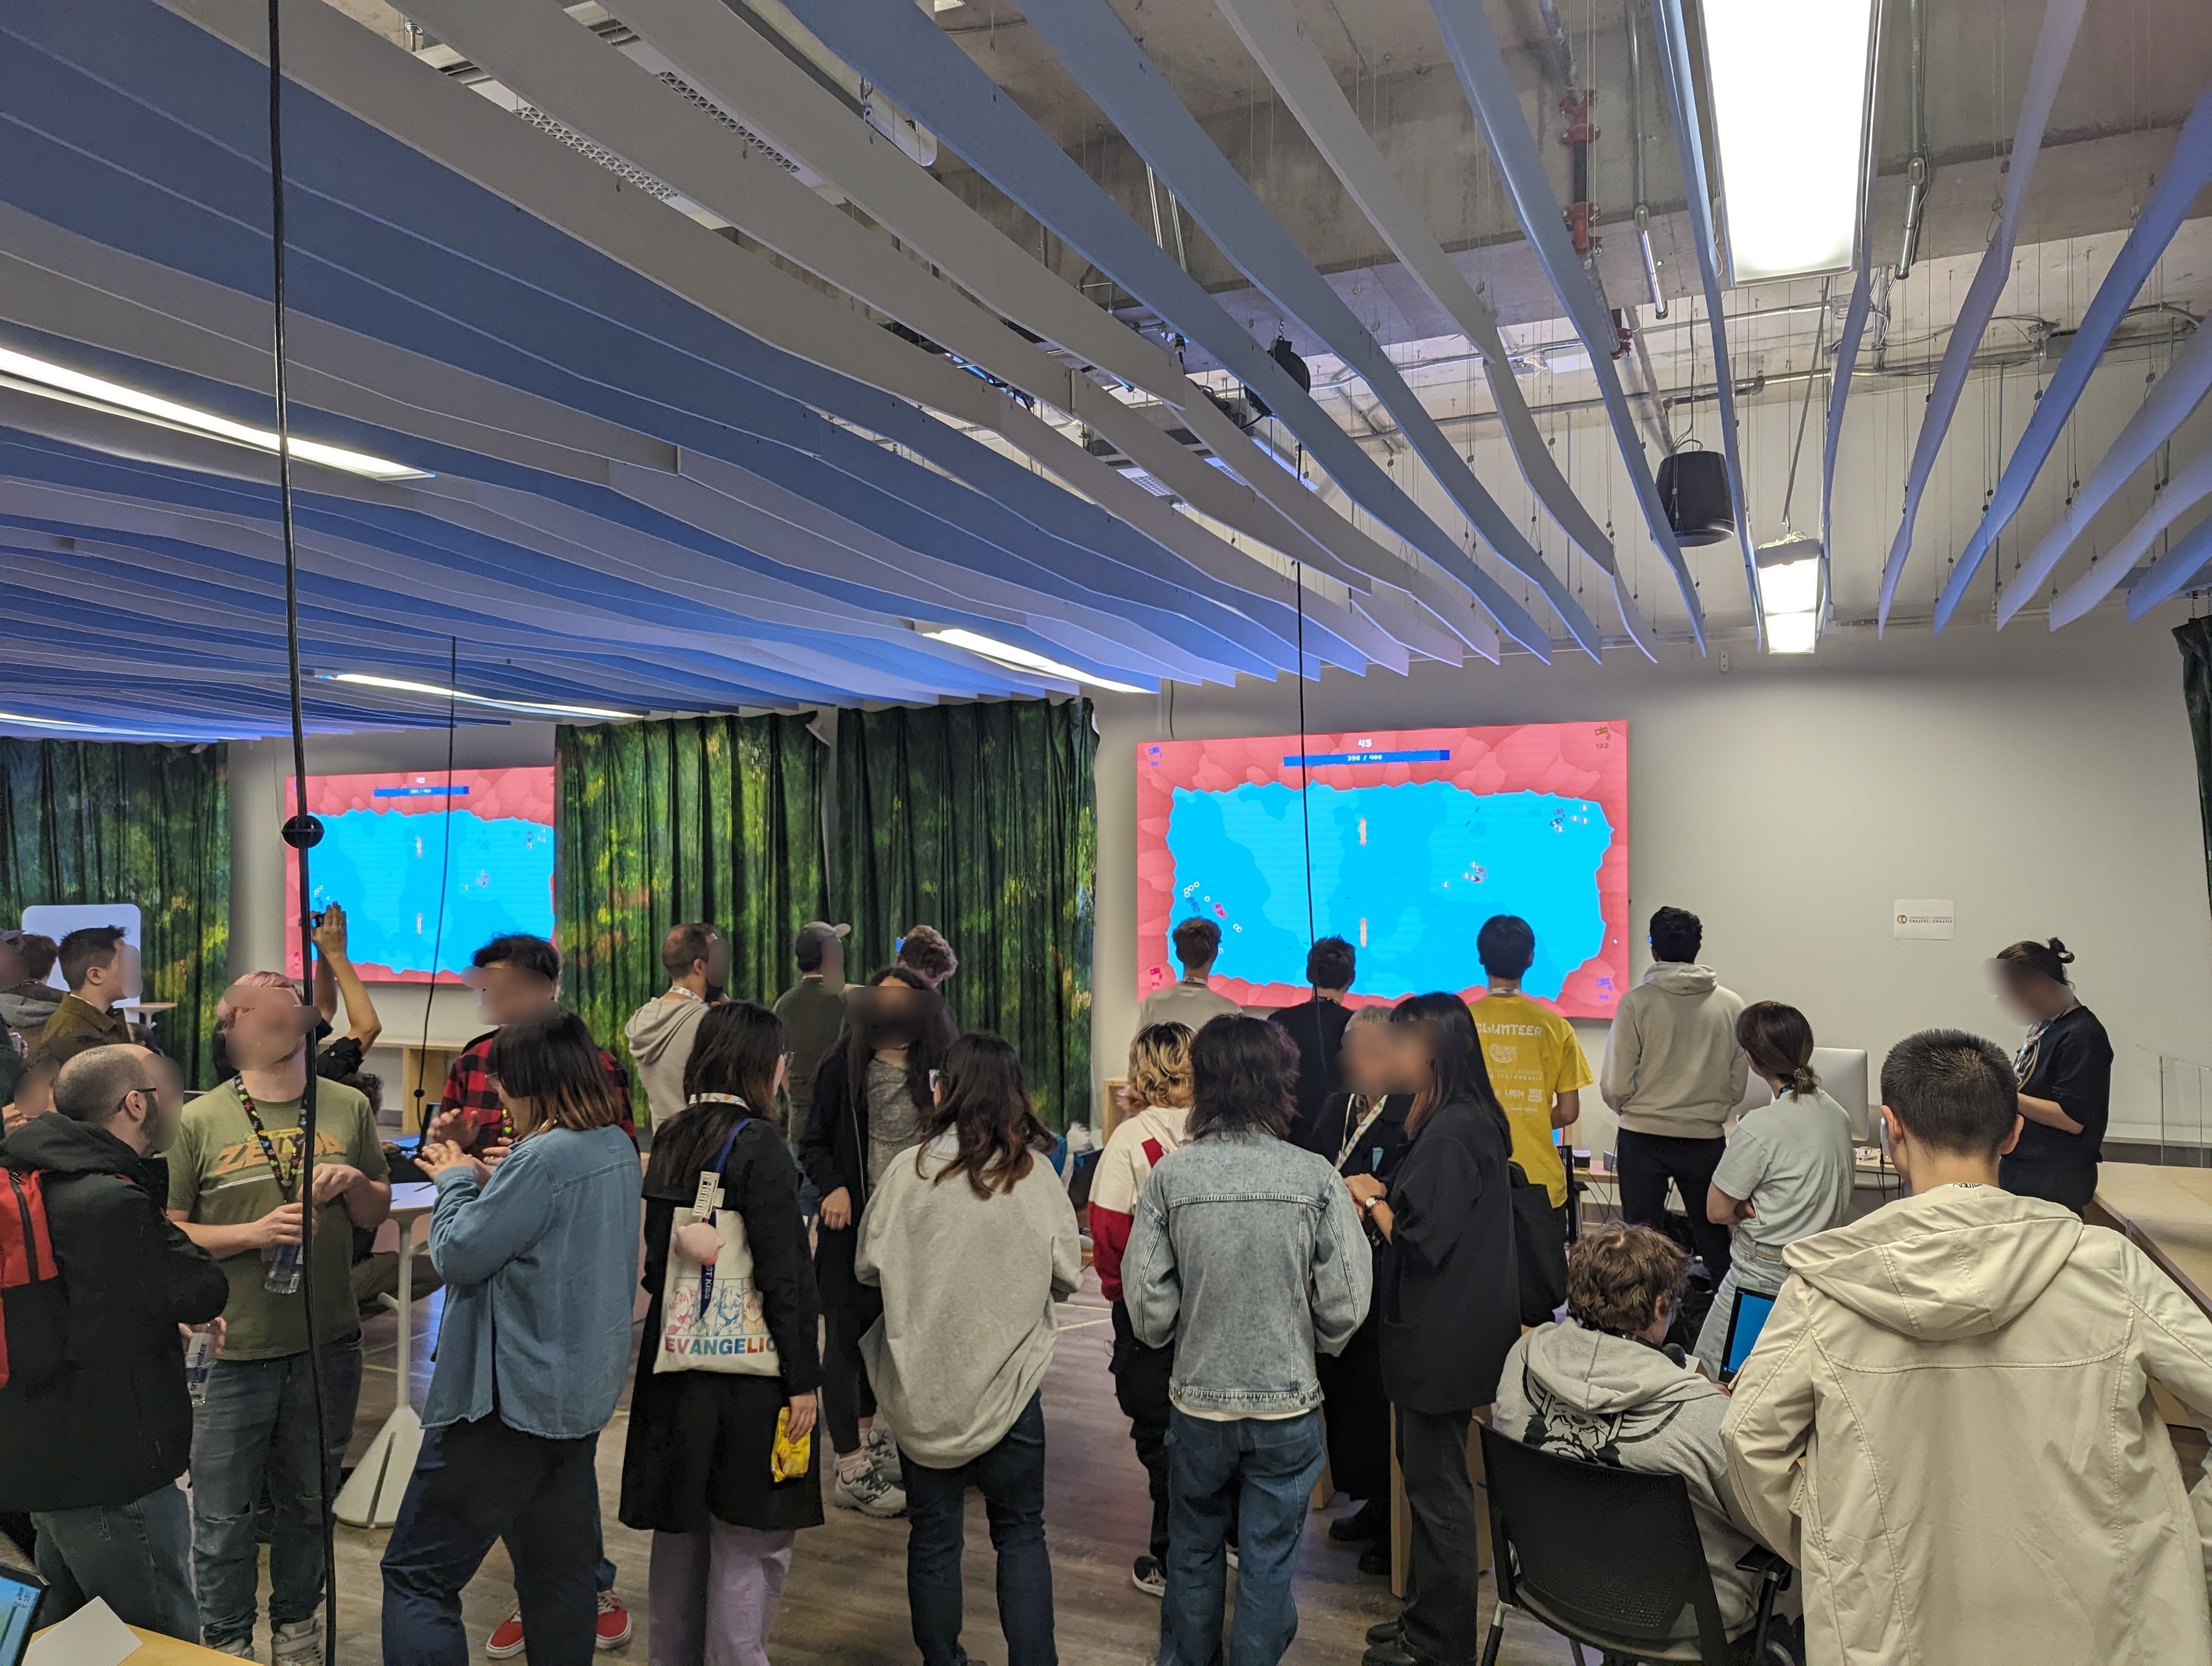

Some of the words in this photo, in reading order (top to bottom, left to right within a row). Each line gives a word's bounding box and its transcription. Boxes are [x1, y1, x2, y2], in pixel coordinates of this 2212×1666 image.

[1358, 739, 1372, 748] 45
[1475, 1022, 1542, 1037] OLUNTEER
[704, 1279, 712, 1299] KISS
